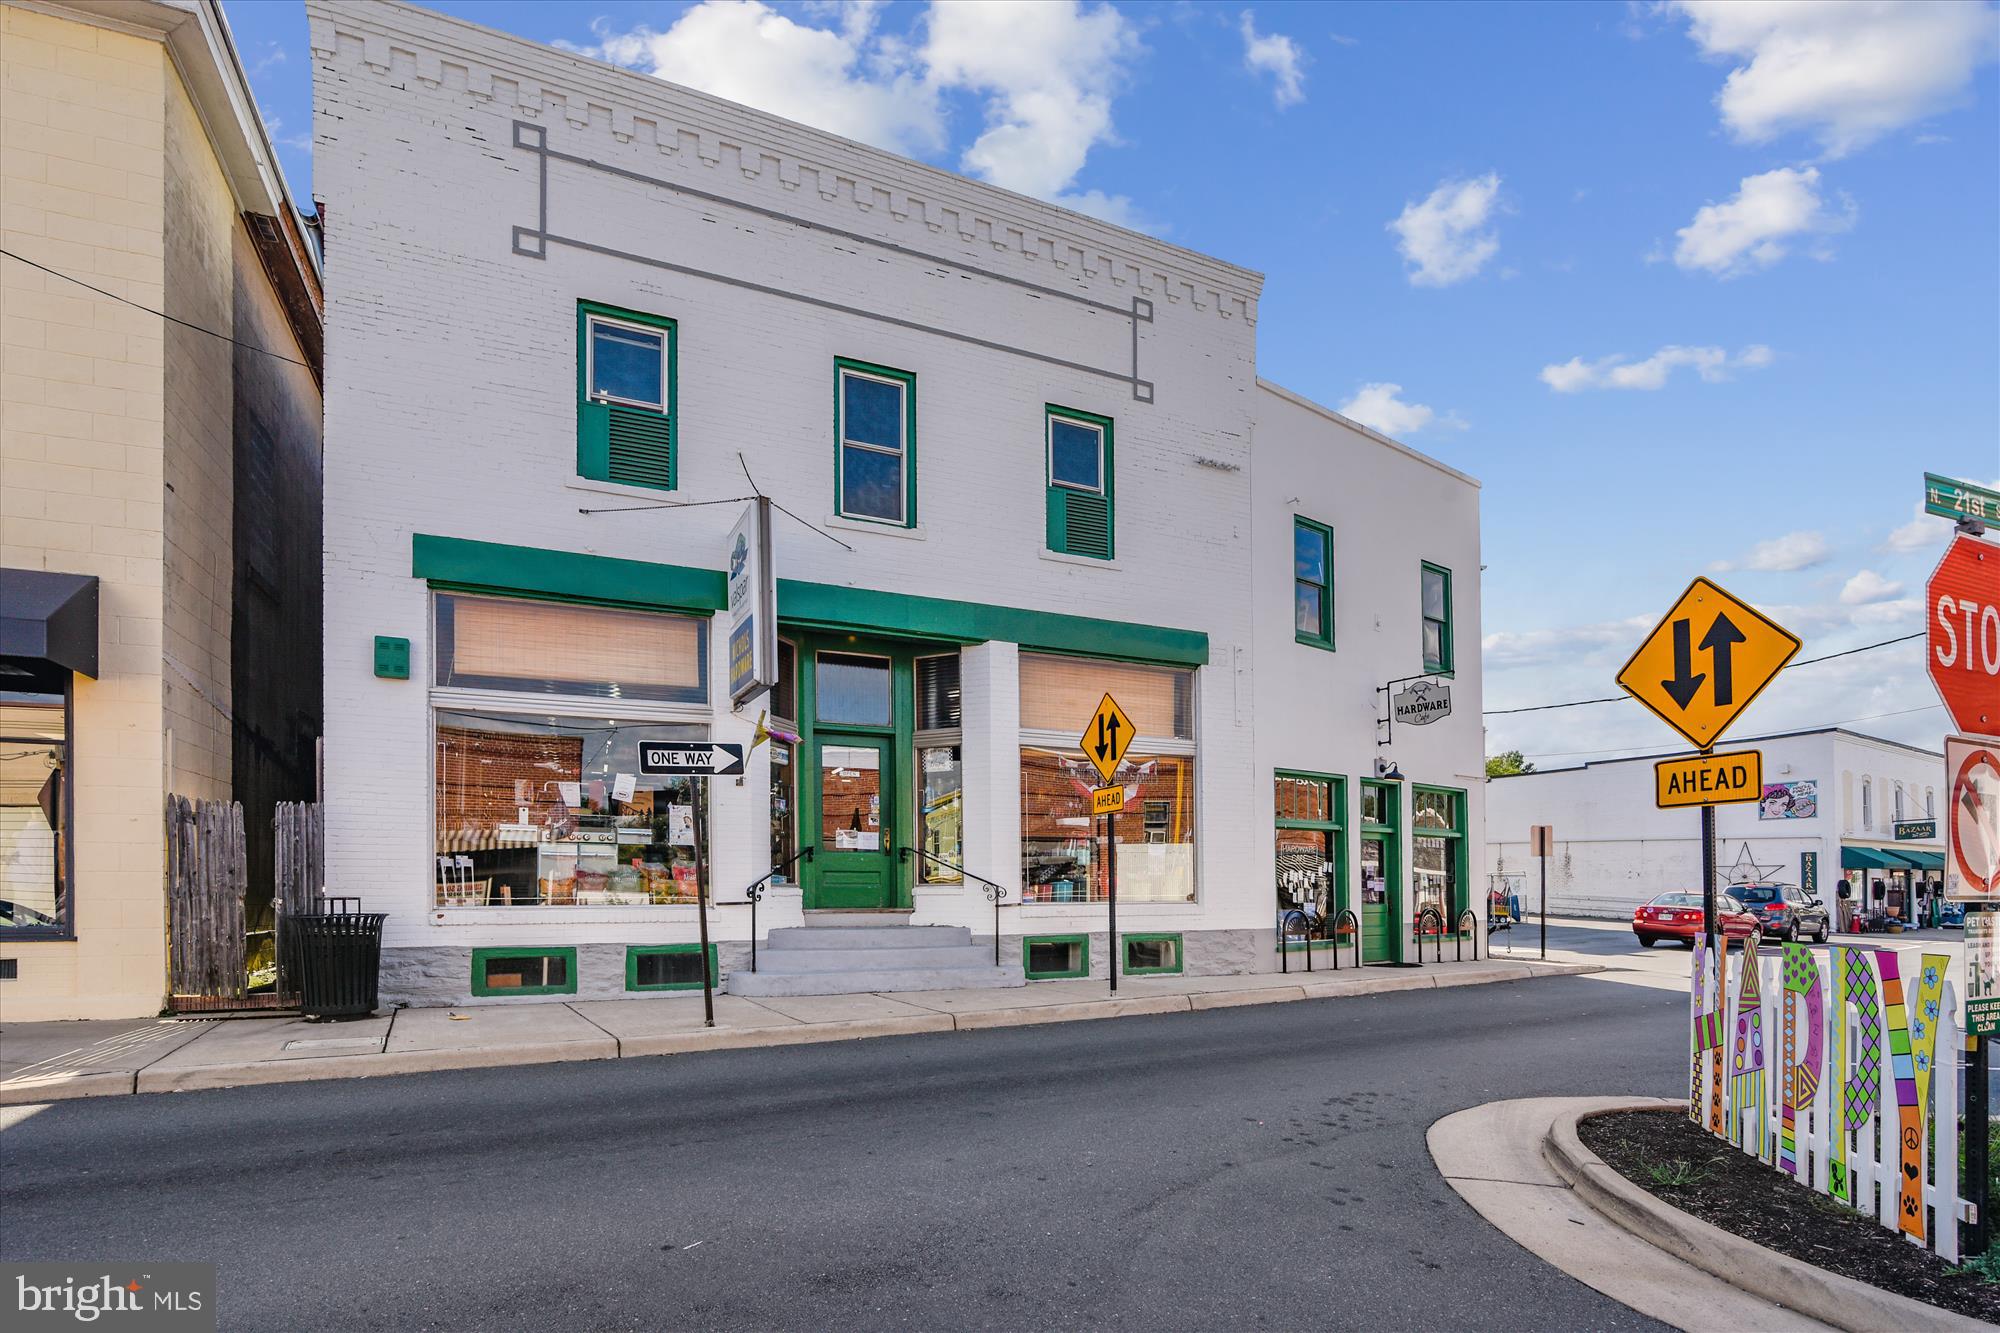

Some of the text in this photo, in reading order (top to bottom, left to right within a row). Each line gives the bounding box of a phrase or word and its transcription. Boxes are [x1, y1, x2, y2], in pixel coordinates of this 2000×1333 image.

[1930, 487, 1941, 504] N.
[1954, 488, 1985, 517] 21st
[1397, 699, 1449, 716] HARDWARE
[651, 751, 713, 766] ONE WAY
[1668, 766, 1748, 795] AHEAD
[1096, 792, 1121, 808] AHEAD
[1898, 825, 1932, 836] BAZAAR
[1805, 855, 1813, 889] BAZAAR
[1966, 917, 1979, 927] PET
[1967, 1002, 1989, 1012] PLEASE
[1972, 1010, 2000, 1023] THIS AREA
[1689, 931, 1951, 1241] HAPPY
